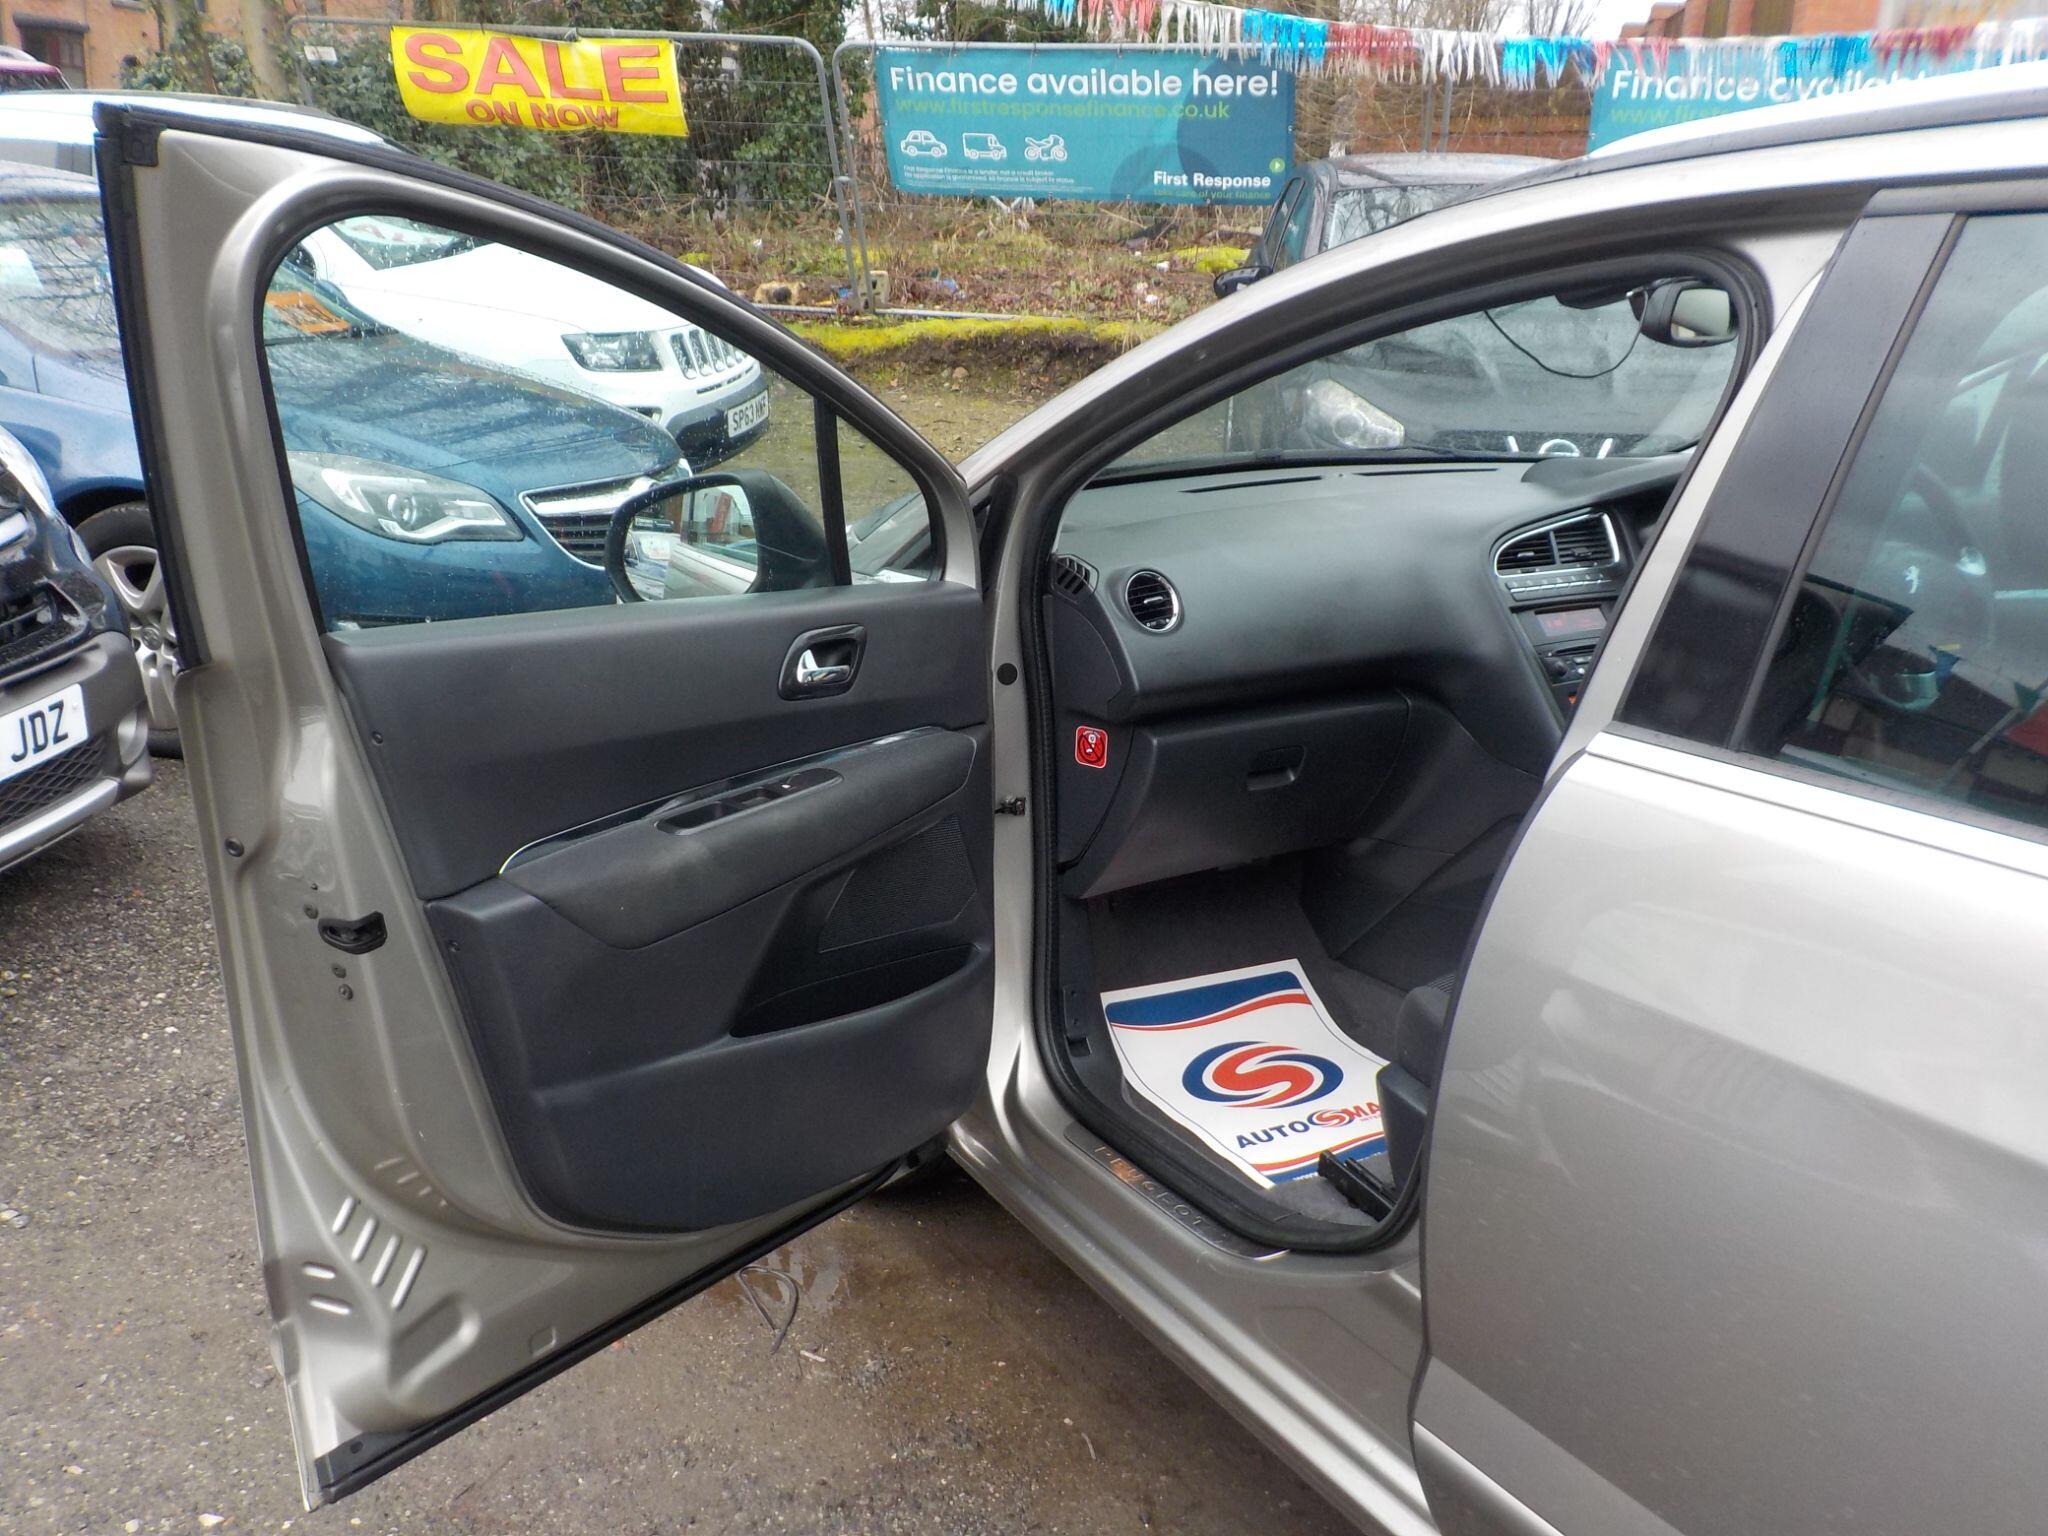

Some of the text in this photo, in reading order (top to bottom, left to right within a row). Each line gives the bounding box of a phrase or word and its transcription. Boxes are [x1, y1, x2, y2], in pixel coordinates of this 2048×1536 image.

[405, 32, 668, 103] SALE
[890, 65, 1279, 97] Finance available here!
[1611, 69, 1926, 102] Finance avail
[465, 99, 619, 129] ON NOW
[895, 97, 1230, 121] www.firstresponsefinance.co.uk
[1153, 170, 1271, 190] First Response
[732, 403, 754, 431] SP63
[10, 700, 69, 763] JDZ
